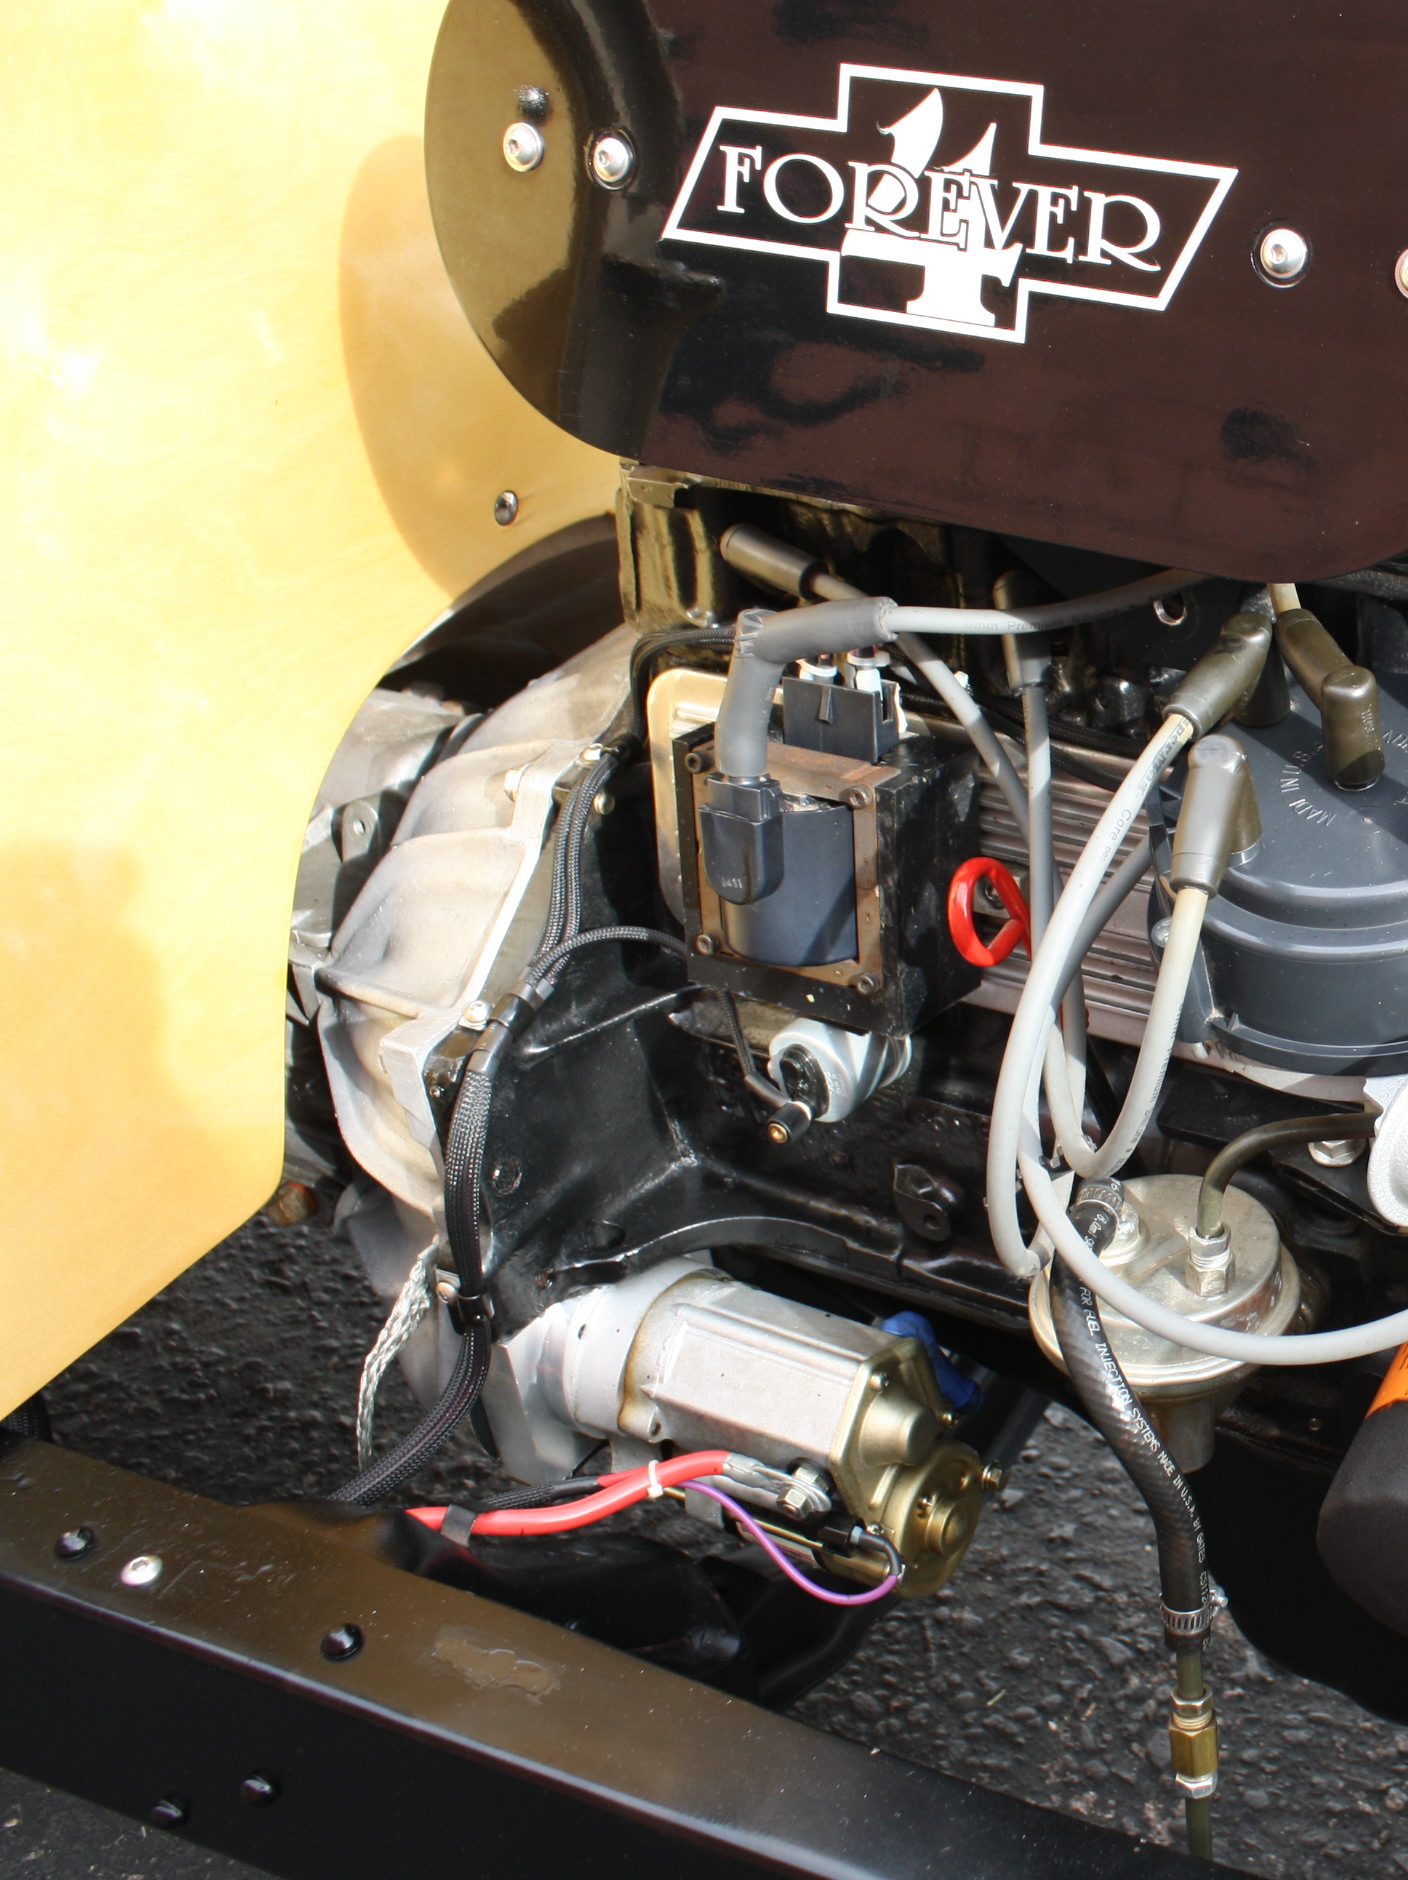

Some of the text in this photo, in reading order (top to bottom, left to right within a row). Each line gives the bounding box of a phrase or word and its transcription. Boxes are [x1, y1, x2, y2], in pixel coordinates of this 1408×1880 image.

[716, 145, 1162, 272] FOREVER
[1007, 618, 1064, 631] Premium
[1111, 809, 1132, 841] Core
[1080, 1286, 1093, 1306] FOR
[1084, 1309, 1101, 1337] FUEL
[1095, 1342, 1133, 1405] INJECTION
[1129, 1407, 1160, 1452] SYSTEMS
[1157, 1450, 1176, 1477] MADE
[1172, 1474, 1184, 1490] IN
